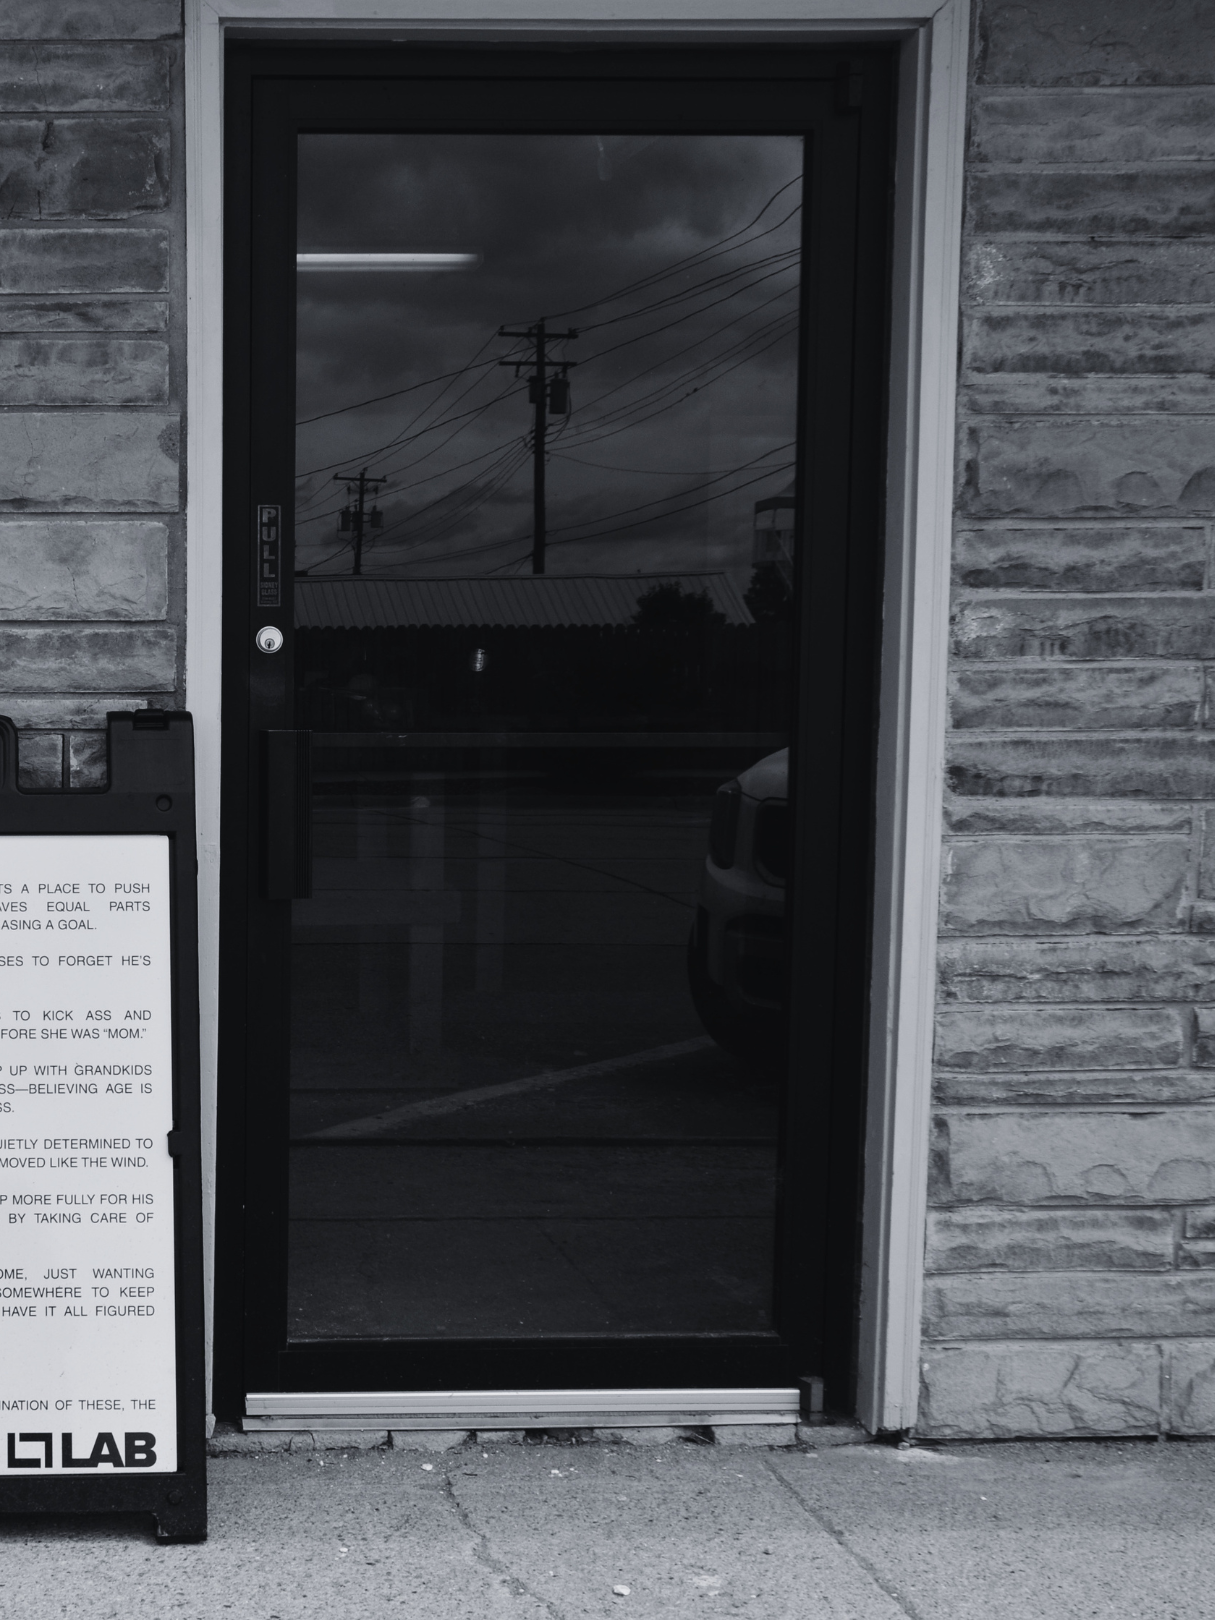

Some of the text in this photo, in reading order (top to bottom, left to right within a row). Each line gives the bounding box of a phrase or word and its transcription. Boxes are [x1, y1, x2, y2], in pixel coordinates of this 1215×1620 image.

[262, 508, 277, 578] PULL
[21, 884, 29, 893] A
[39, 883, 80, 894] PLACE
[88, 883, 105, 893] TO
[115, 883, 150, 893] PUSH
[47, 901, 90, 912] EQUAL
[110, 901, 150, 911] PARTS
[46, 920, 54, 930] A
[58, 919, 97, 930] GOAL.
[32, 956, 49, 966] TO
[59, 955, 113, 966] FORGET
[12, 1010, 30, 1021] TO
[43, 1010, 73, 1021] KICK
[86, 1010, 111, 1021] ASS
[124, 1010, 151, 1020] AND
[41, 1029, 67, 1039] SHE
[71, 1028, 100, 1039] WAS
[10, 1065, 27, 1076] UP
[34, 1065, 67, 1075] WITH
[74, 1065, 152, 1076] GRANDKIDS
[106, 1083, 132, 1094] AGE
[141, 1083, 152, 1094] IS
[44, 1138, 130, 1149] DETERMINED
[135, 1138, 153, 1149] TO
[50, 1157, 78, 1168] LIKE
[81, 1157, 107, 1167] THE
[111, 1157, 149, 1167] WIND.
[13, 1194, 51, 1205] MORE
[57, 1194, 95, 1205] FULLY
[100, 1194, 127, 1204] FOR
[132, 1194, 153, 1204] HIS
[9, 1213, 26, 1224] BY
[34, 1213, 81, 1223] TAKING
[90, 1213, 126, 1223] CARE
[136, 1212, 154, 1223] OF
[44, 1268, 77, 1279] JUST
[93, 1268, 154, 1278] WANTING
[91, 1287, 109, 1298] TO
[120, 1287, 154, 1297] KEEP
[2, 1306, 37, 1317] HAVE
[45, 1306, 56, 1316] IT
[64, 1306, 88, 1316] ALL
[96, 1305, 155, 1316] FIGURED
[55, 1400, 72, 1410] OF
[78, 1400, 124, 1411] THESE,
[130, 1399, 156, 1409] THE
[62, 1432, 157, 1468] LAB
